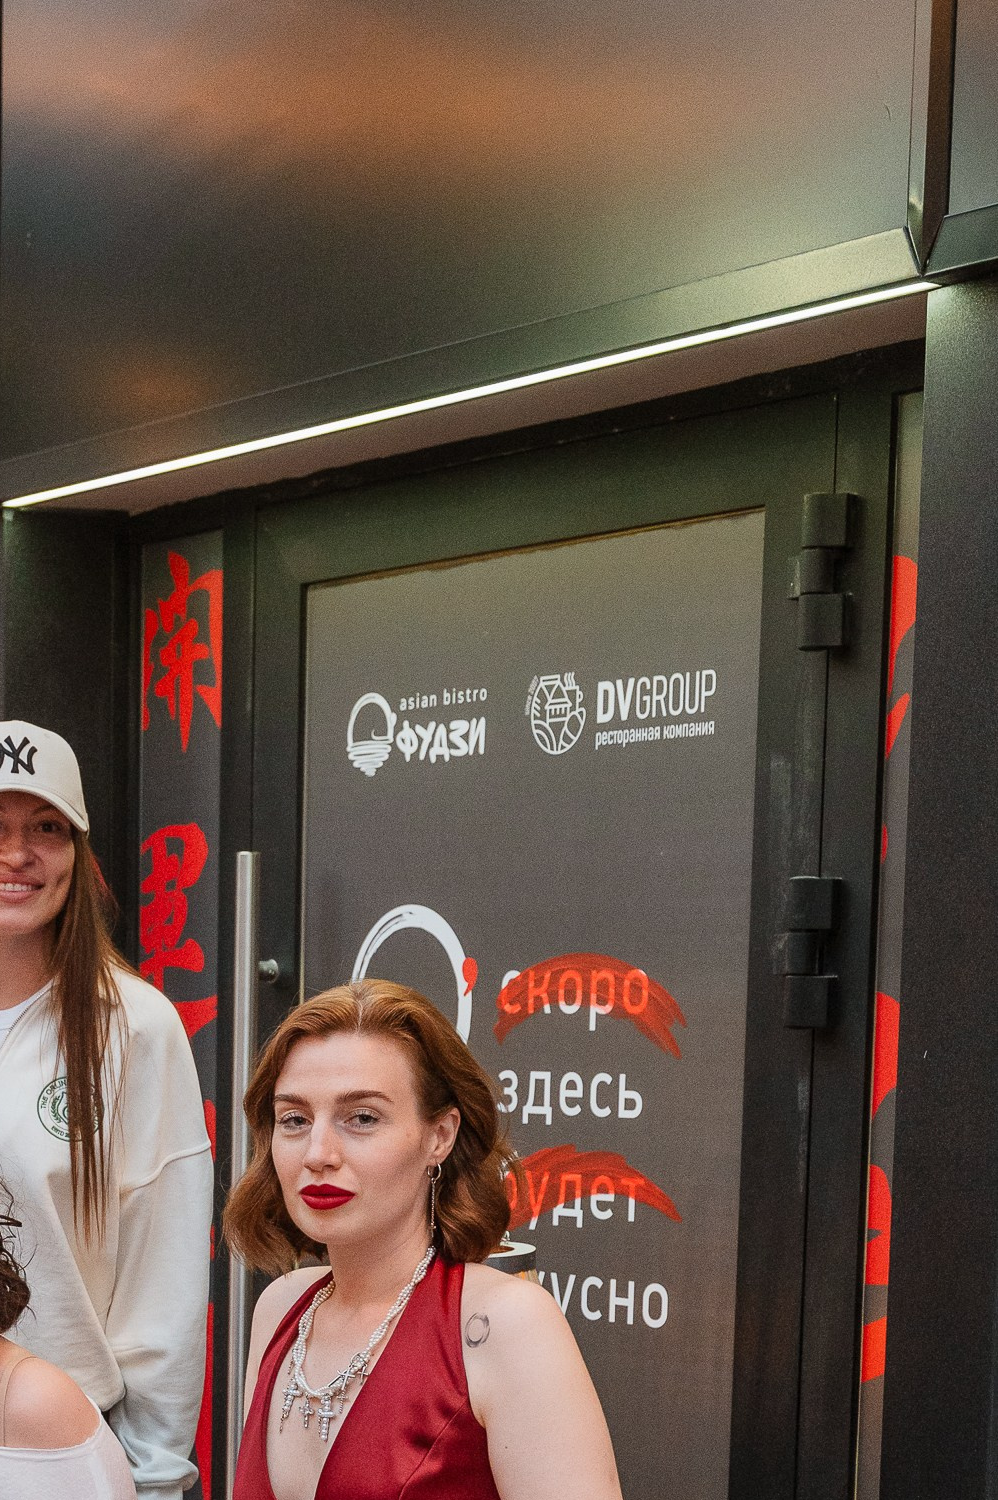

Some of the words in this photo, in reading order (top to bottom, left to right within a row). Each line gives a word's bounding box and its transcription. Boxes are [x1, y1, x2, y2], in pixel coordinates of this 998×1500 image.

[399, 692, 437, 711] asian
[443, 687, 488, 706] bistro
[595, 725, 661, 751] ресторанная
[663, 720, 715, 740] компания
[501, 969, 650, 1032] скоро
[497, 1070, 643, 1126] здесь
